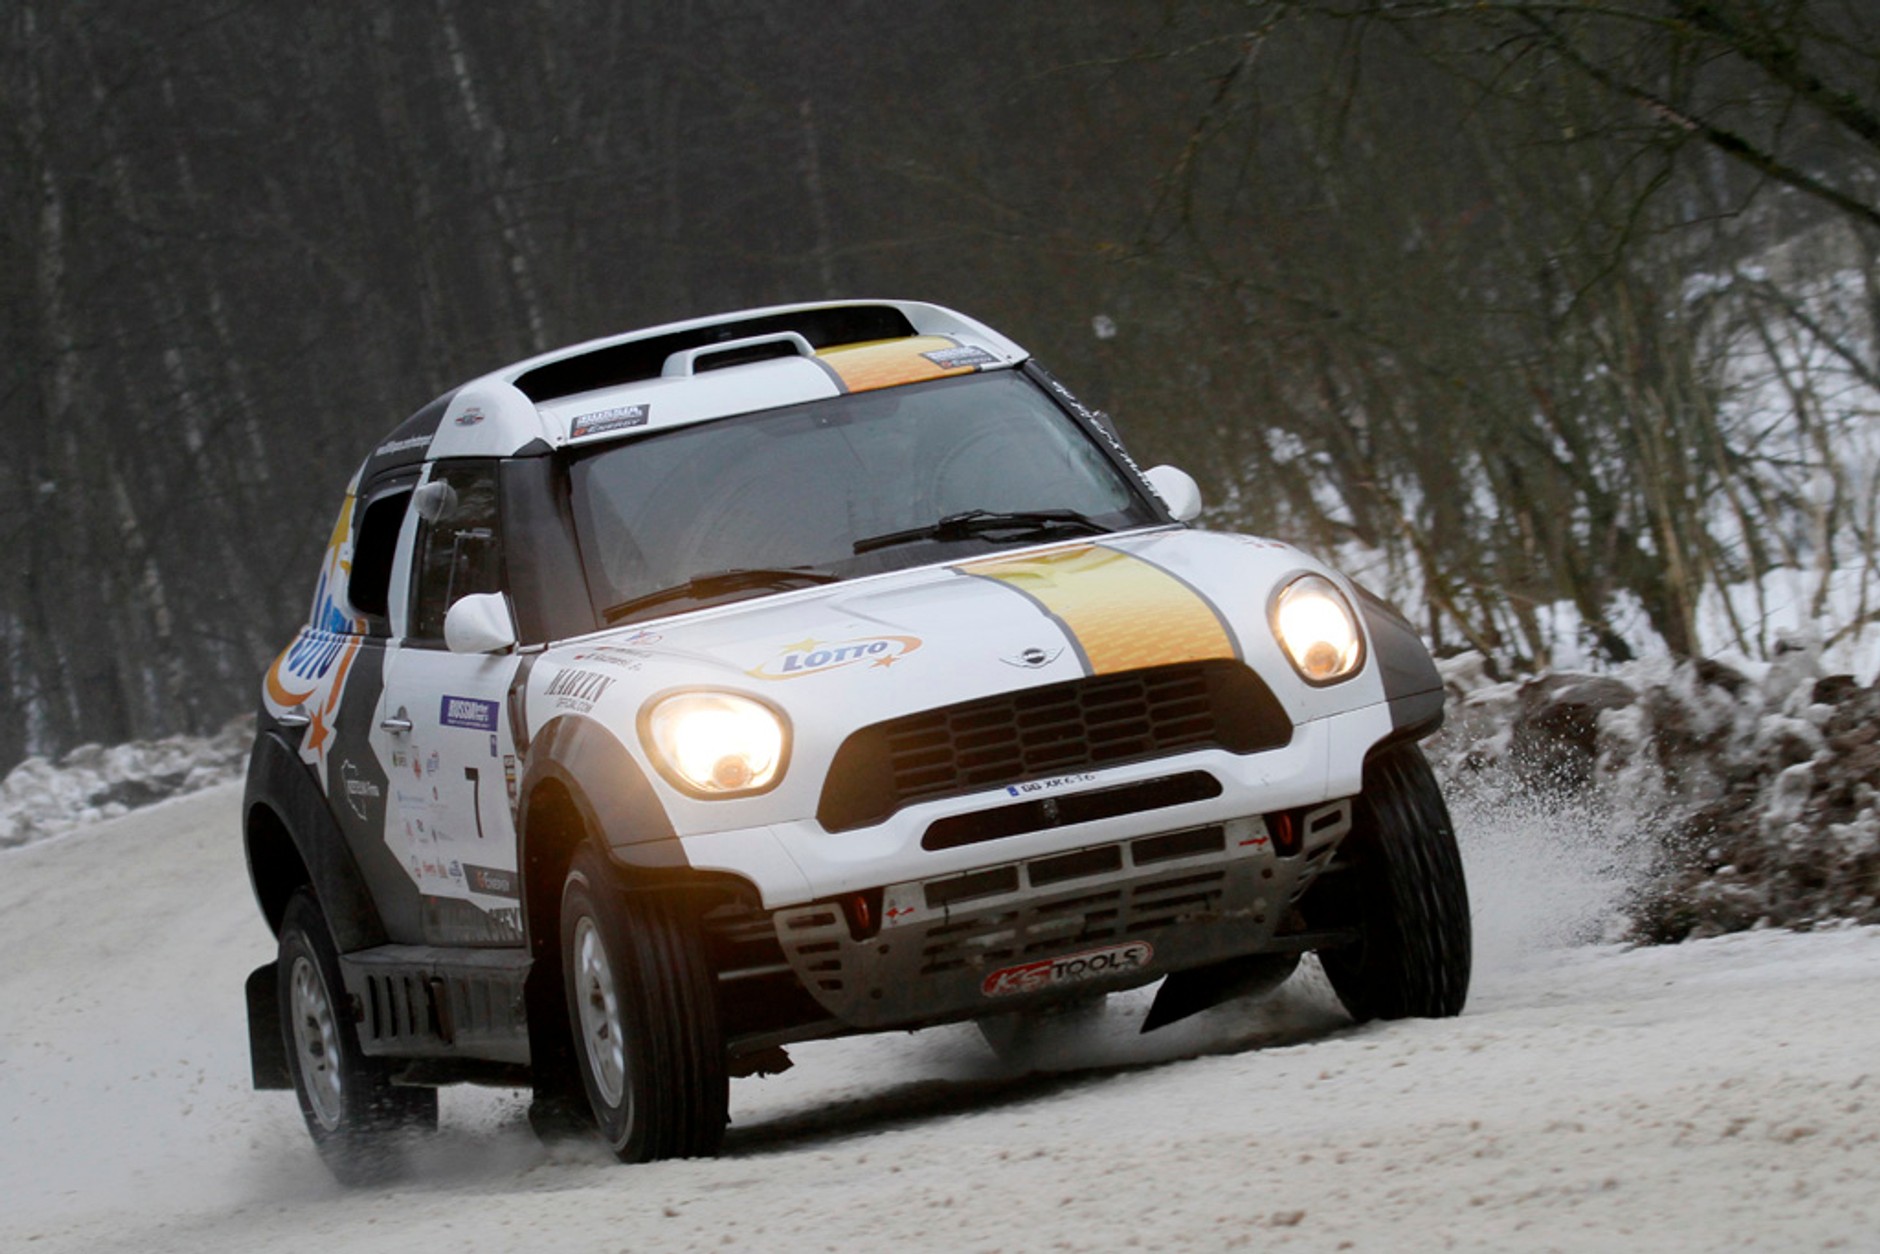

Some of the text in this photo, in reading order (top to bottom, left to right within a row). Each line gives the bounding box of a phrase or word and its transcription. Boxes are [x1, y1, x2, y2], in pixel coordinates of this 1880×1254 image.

[782, 640, 888, 672] LOTTO
[543, 668, 616, 703] MARTIN
[464, 766, 483, 838] 7
[1052, 948, 1144, 979] TOOLS
